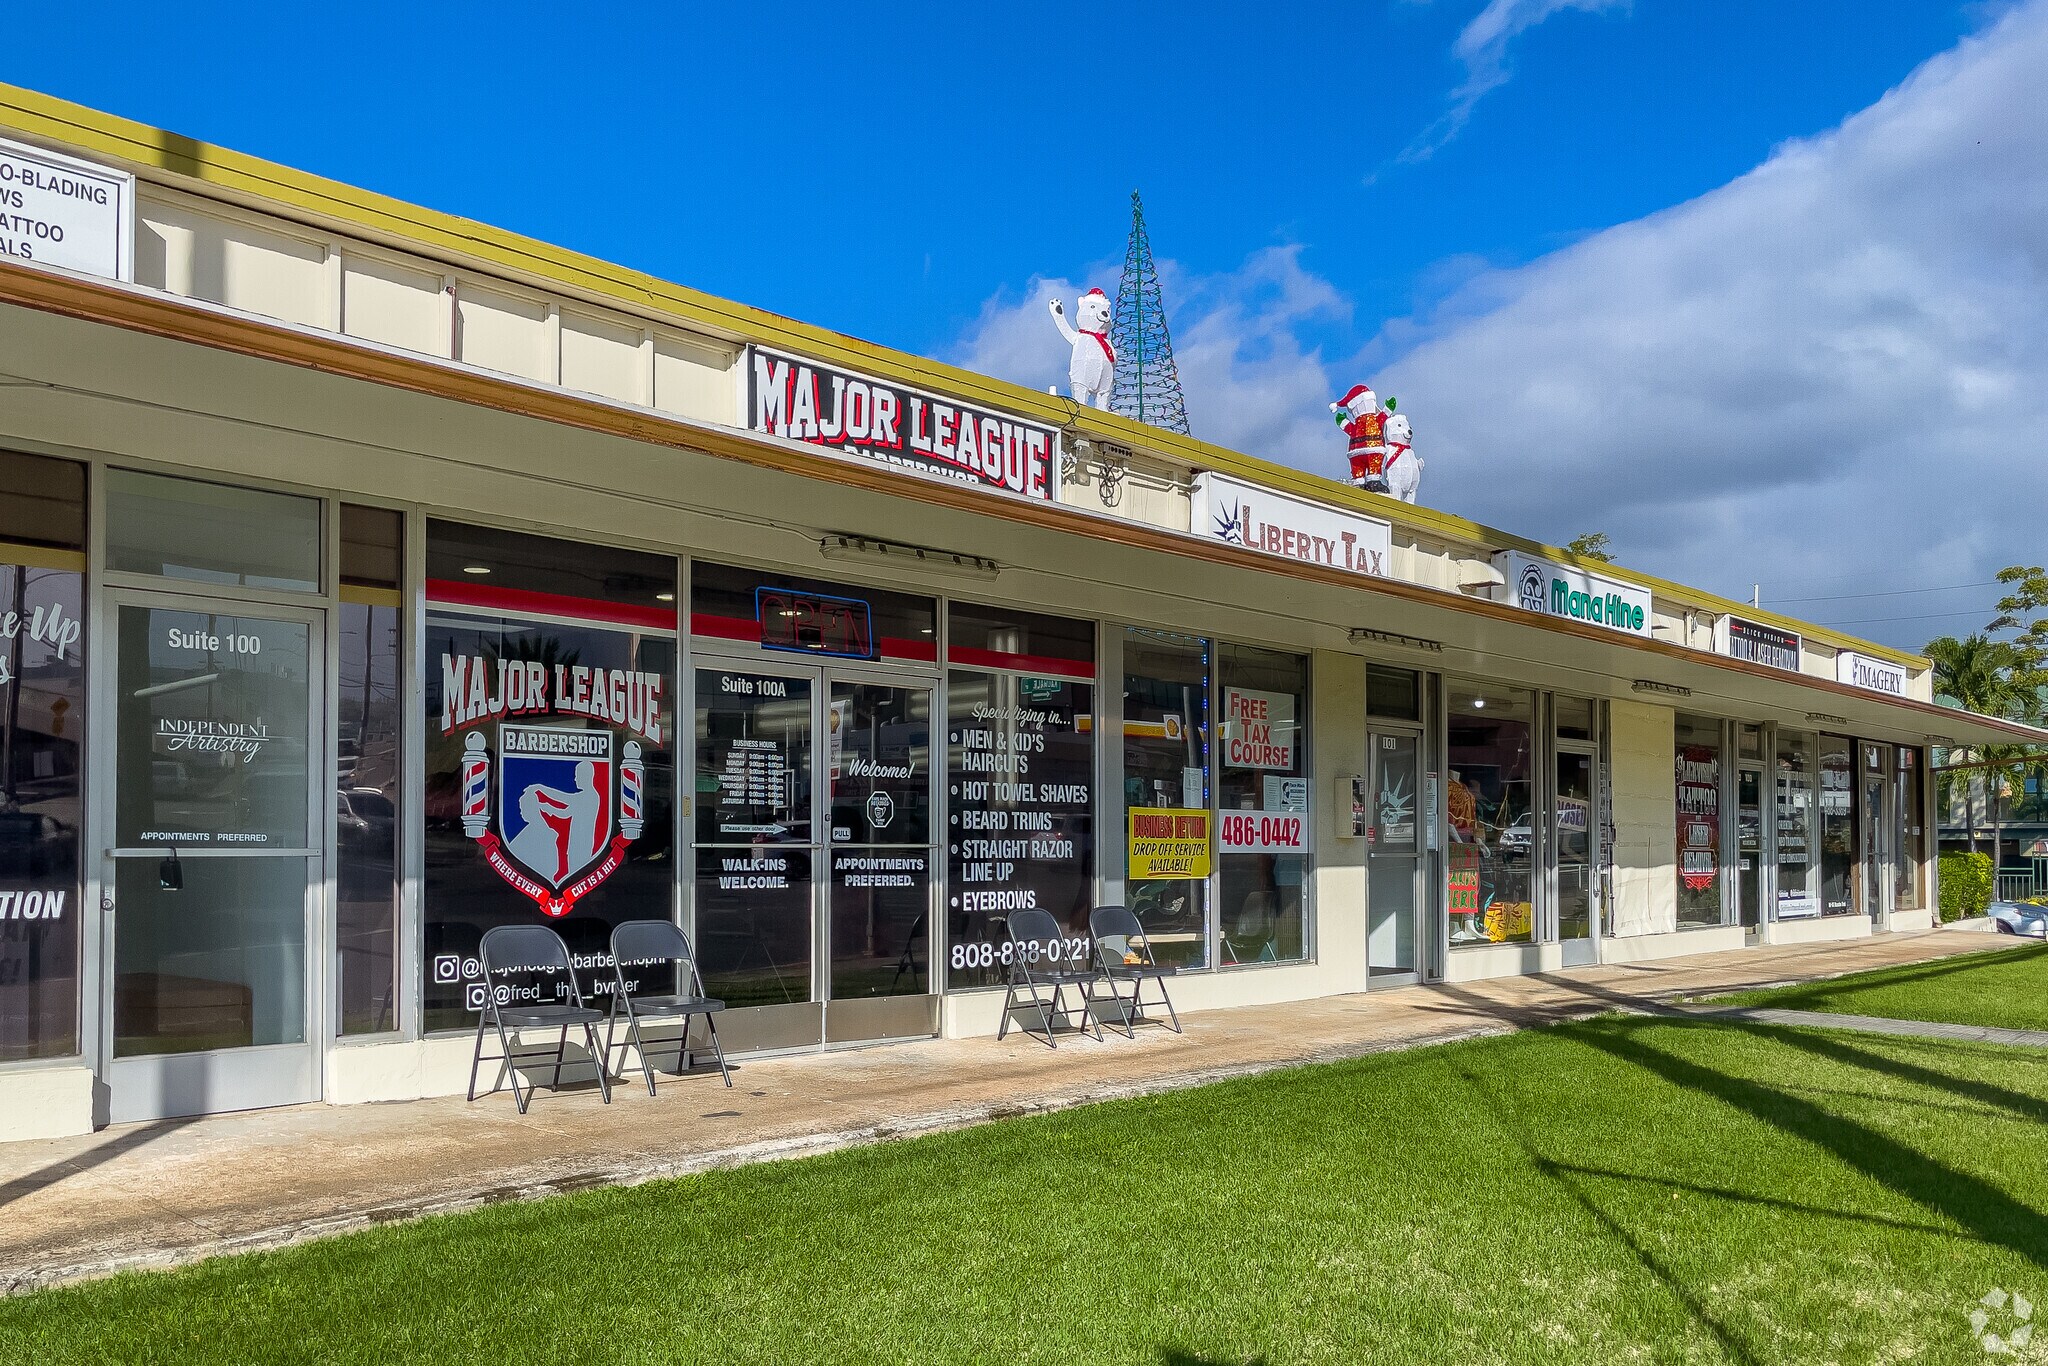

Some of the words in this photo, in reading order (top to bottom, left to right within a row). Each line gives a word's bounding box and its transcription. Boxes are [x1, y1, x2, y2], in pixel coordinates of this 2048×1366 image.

[754, 353, 902, 449] MAJOR
[909, 396, 1049, 499] LEAGUE
[1551, 578, 1604, 623] Mana
[1605, 592, 1644, 630] Hine
[31, 602, 80, 660] Up
[762, 595, 869, 655] OPEN
[1743, 627, 1761, 637] SLICK
[1763, 633, 1784, 643] VISION
[168, 628, 220, 651] Suite
[226, 633, 261, 654] 100
[721, 676, 753, 694] Suite
[756, 680, 787, 697] 100A
[1859, 664, 1902, 693] IMAGERY
[441, 653, 549, 737] MAJOR
[555, 664, 664, 749] LEAGUE
[1231, 692, 1268, 719] FREE
[972, 701, 1046, 730] Specializing
[160, 718, 268, 737] INDEPENDENT
[1241, 719, 1271, 744] TAX
[167, 728, 262, 763] Artistry
[505, 731, 608, 755] BARBERSHOP
[962, 729, 993, 749] MEN
[996, 731, 1007, 750] &
[1383, 738, 1395, 749] 101
[962, 752, 1029, 774] HAIRCUTS
[1231, 738, 1289, 767] COURSE
[849, 759, 915, 778] Welcome!
[962, 781, 989, 800] HOT
[993, 782, 1037, 802] TOWEL
[1040, 784, 1088, 803] SHAVES
[1679, 785, 1716, 815] TATTOO
[962, 810, 1008, 830] BEARD
[1012, 812, 1053, 830] TRIMS
[1133, 815, 1173, 839] BUSINESS
[1175, 816, 1206, 839] RETURN
[140, 830, 210, 841] APPOINTMENTS
[217, 832, 268, 842] PREFERRED
[1221, 816, 1301, 847] 486-0442
[962, 839, 1028, 859] STRAIGHT
[1031, 840, 1073, 858] RAZOR
[1133, 843, 1157, 856] DROP
[1158, 843, 1174, 856] OFF
[1174, 843, 1206, 856] SERVICE
[489, 851, 518, 882] WHERE
[515, 876, 543, 898] EVERY
[722, 858, 787, 871] WALK-INS
[834, 858, 924, 870] APPOINTMENTS
[962, 862, 993, 882] LINE
[996, 862, 1014, 881] UP
[1147, 858, 1193, 872] AVAILABLE!
[571, 881, 588, 898] CUT
[587, 875, 597, 886] IS
[597, 870, 604, 880] A
[601, 857, 618, 874] HIT
[719, 876, 789, 889] WELCOME.
[844, 874, 915, 887] PREFERRED.
[962, 890, 1036, 911] EYEBROWS
